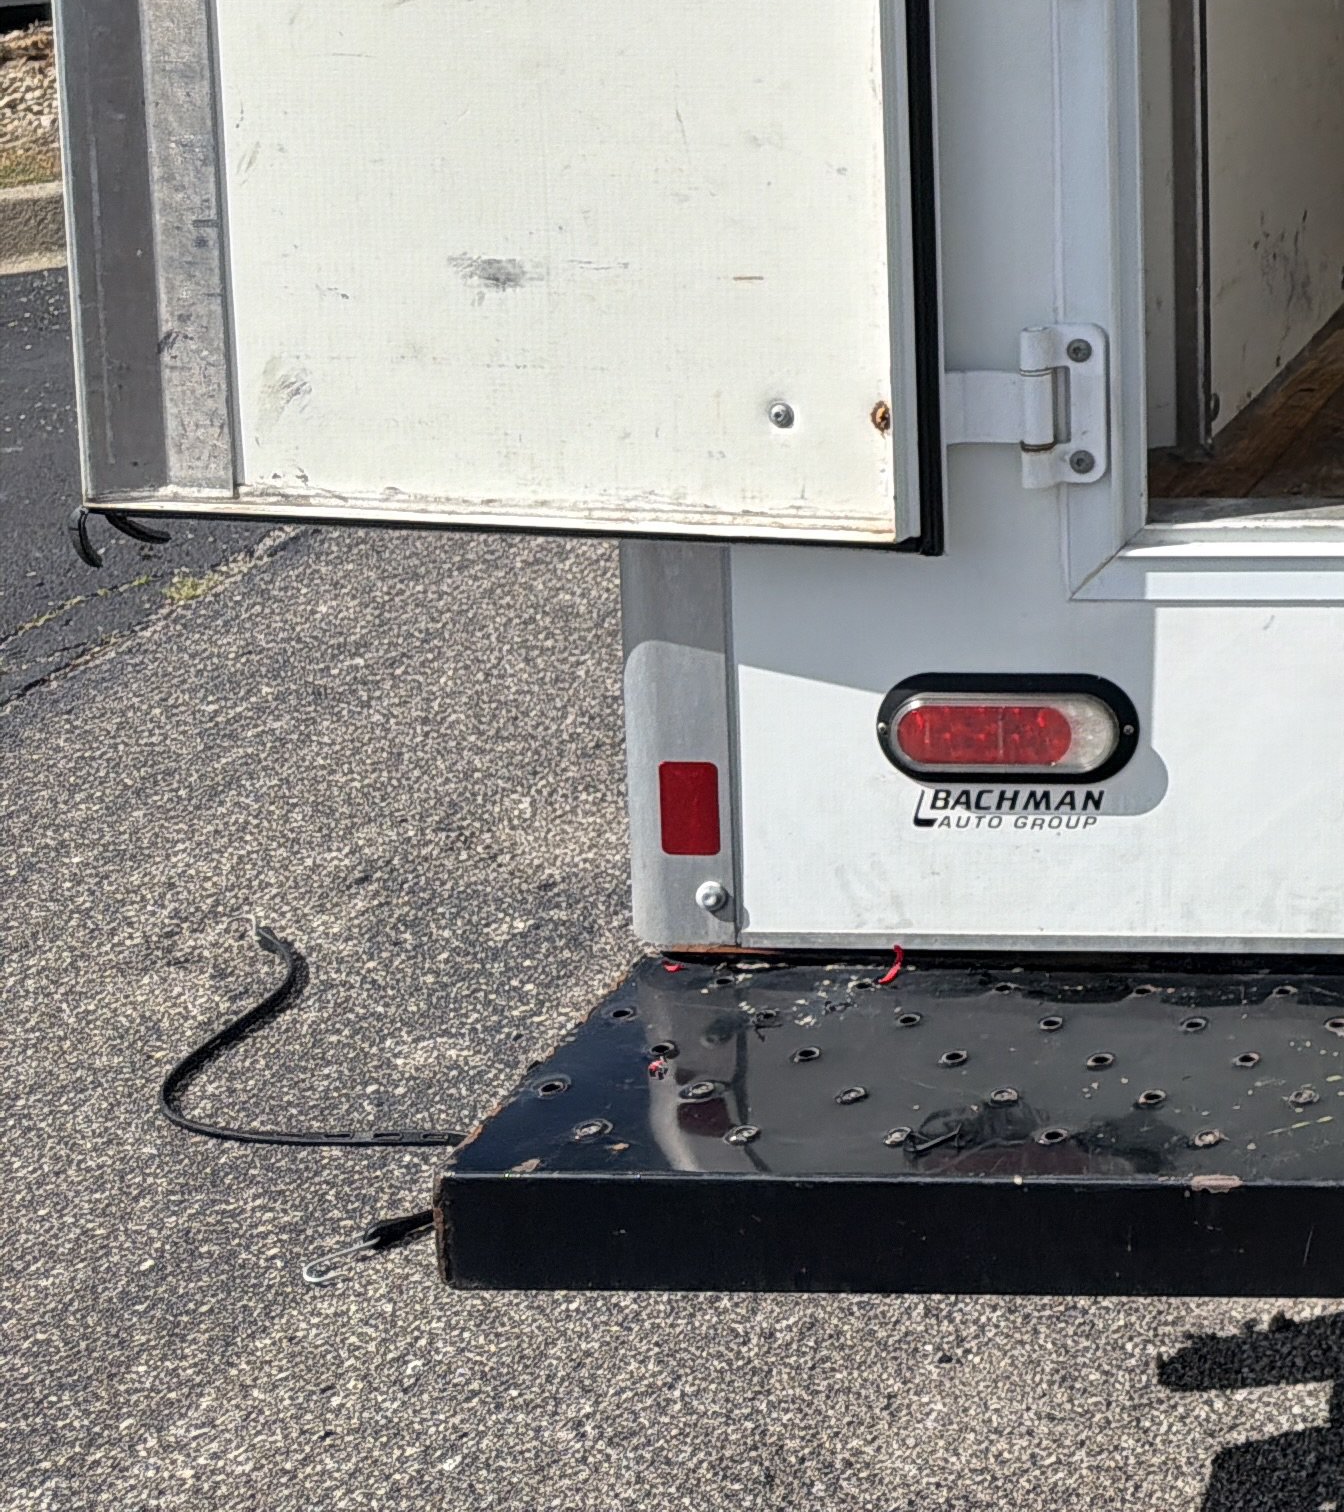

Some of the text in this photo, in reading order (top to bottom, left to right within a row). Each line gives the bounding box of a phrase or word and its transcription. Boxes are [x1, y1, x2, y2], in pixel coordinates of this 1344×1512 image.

[929, 789, 1105, 811] BACHMAN
[937, 815, 1098, 830] AUTO GROUP
